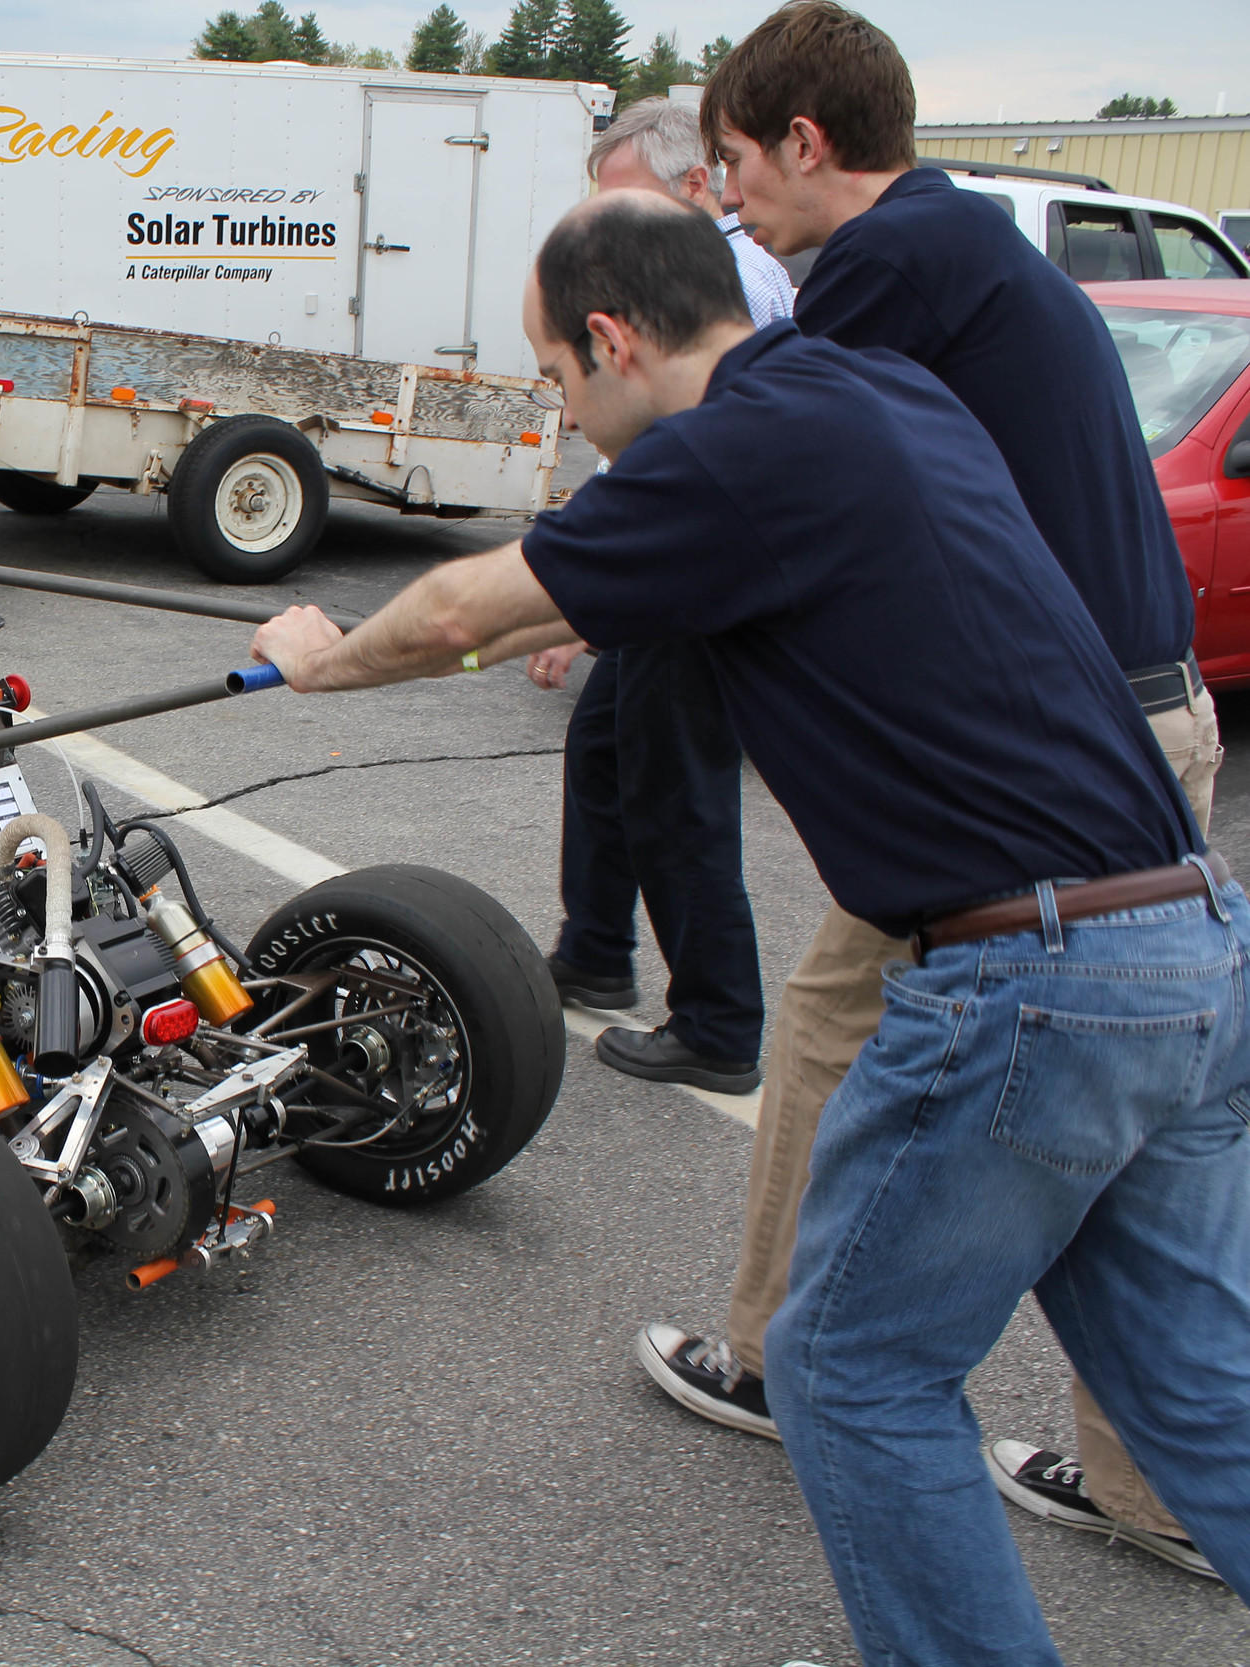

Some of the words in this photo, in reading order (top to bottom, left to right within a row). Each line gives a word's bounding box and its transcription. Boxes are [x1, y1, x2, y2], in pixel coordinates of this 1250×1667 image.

[143, 186, 286, 203] SPONSORED
[290, 189, 325, 204] BY
[126, 212, 205, 245] Solar
[212, 213, 336, 247] Turbines
[126, 264, 136, 280] A
[141, 264, 210, 282] Caterpillar
[214, 264, 273, 282] Company
[245, 910, 338, 998] oosier
[384, 1109, 488, 1192] Hoosier
